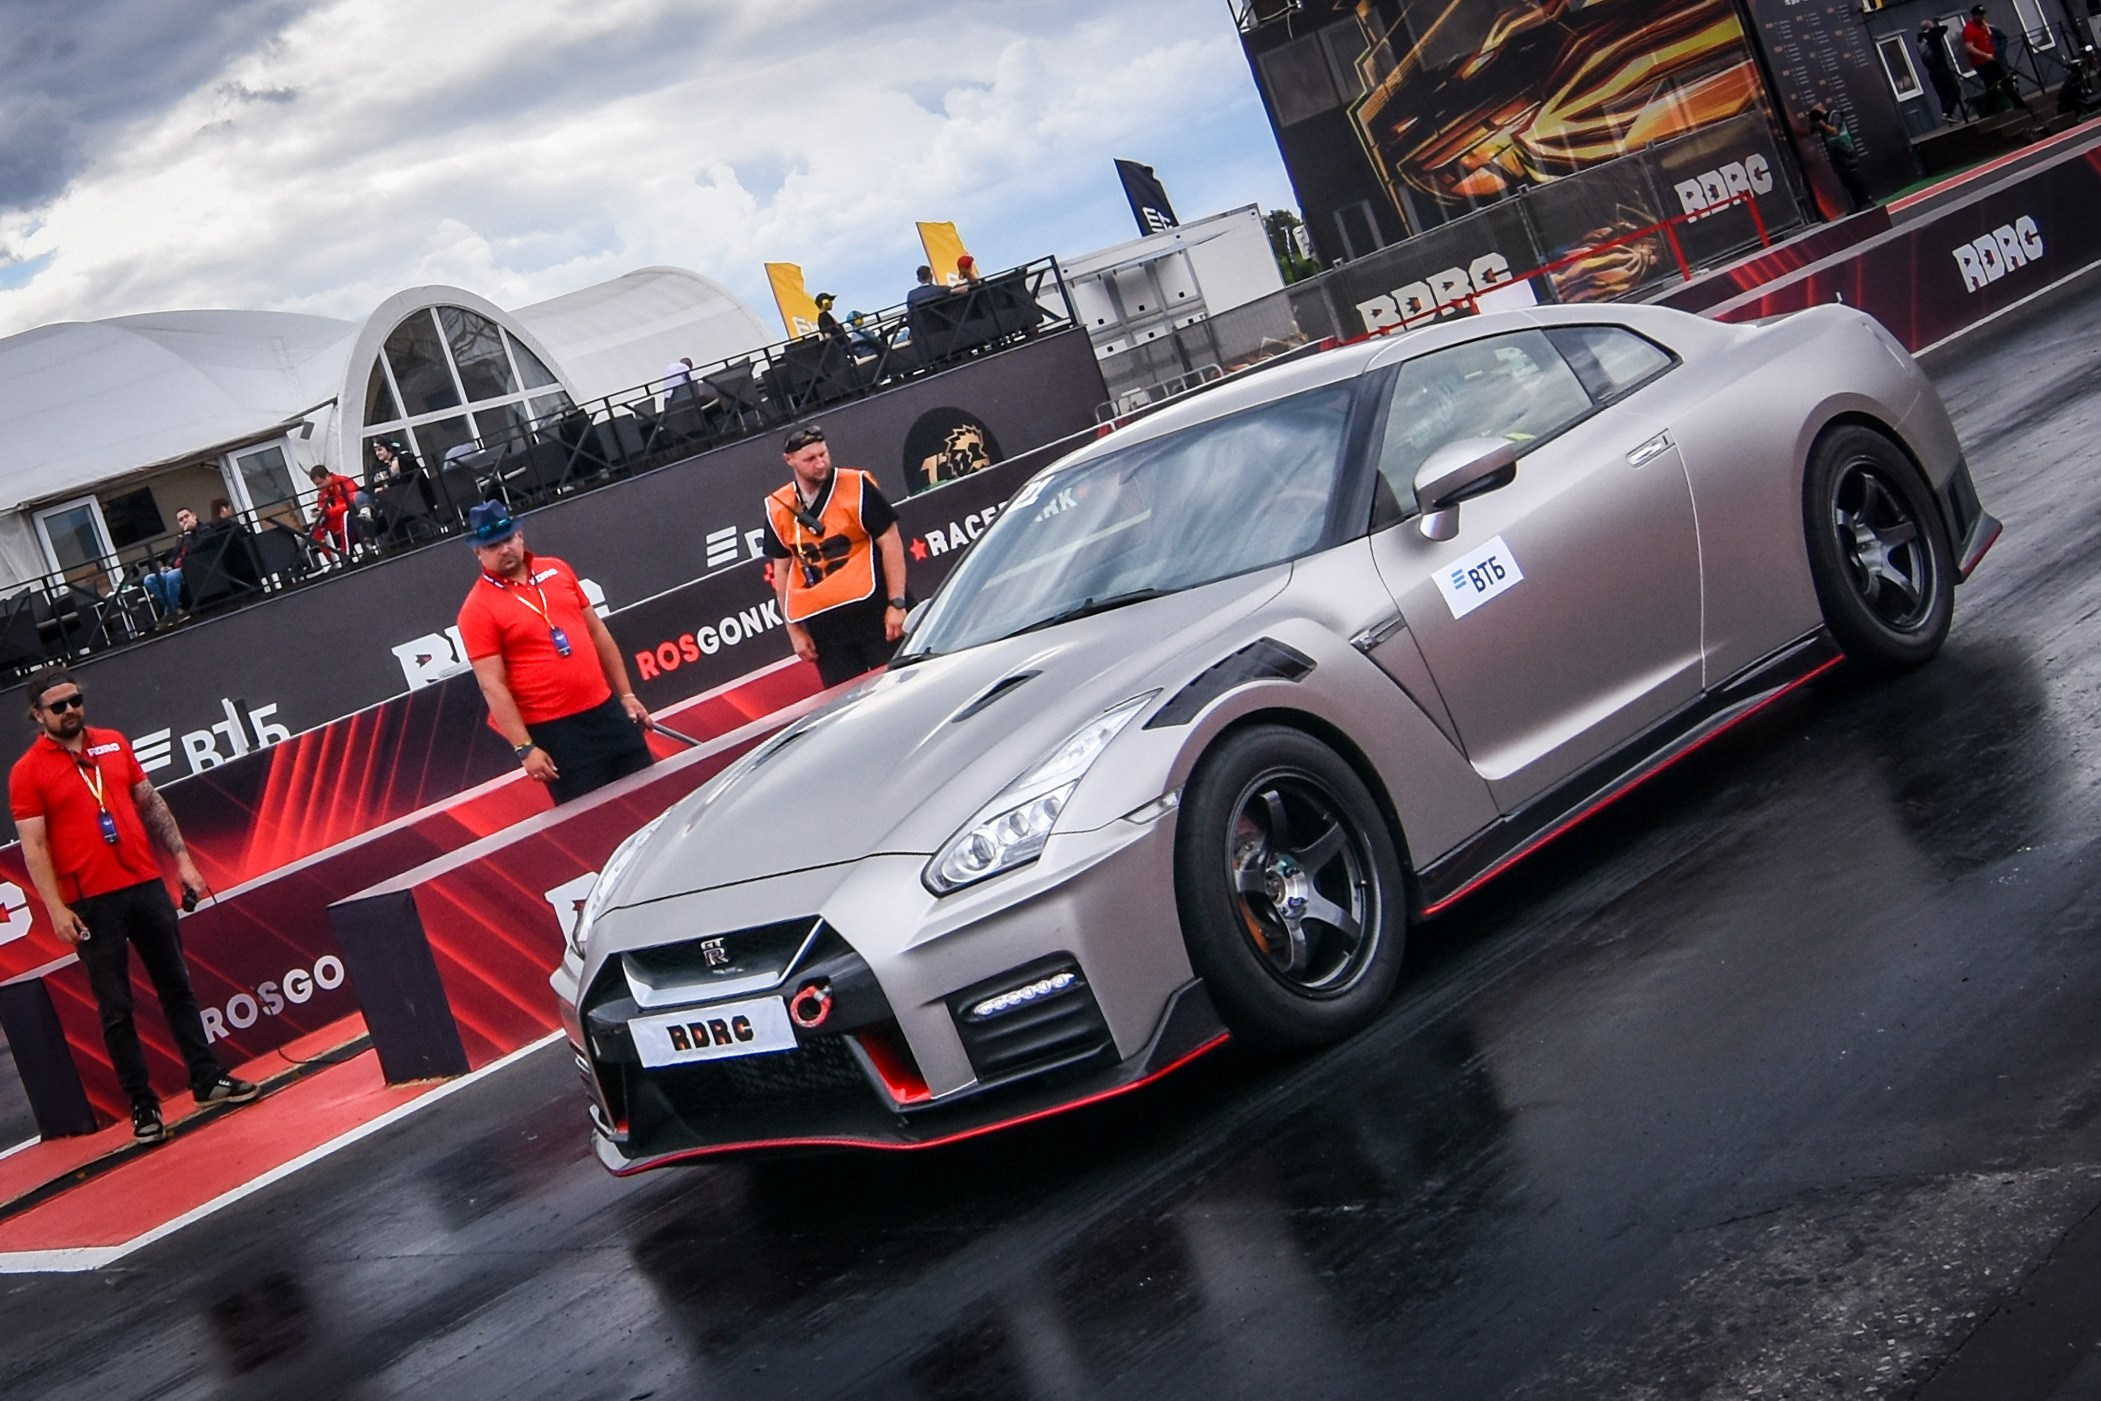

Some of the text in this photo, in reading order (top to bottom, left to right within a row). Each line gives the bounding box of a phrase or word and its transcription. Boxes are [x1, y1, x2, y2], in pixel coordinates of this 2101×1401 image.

[1674, 153, 1773, 223] RDRC
[1952, 215, 2044, 293] RDRC
[1356, 252, 1513, 339] RDRC
[1468, 556, 1506, 593] ВТБ
[666, 1015, 754, 1051] RDRC
